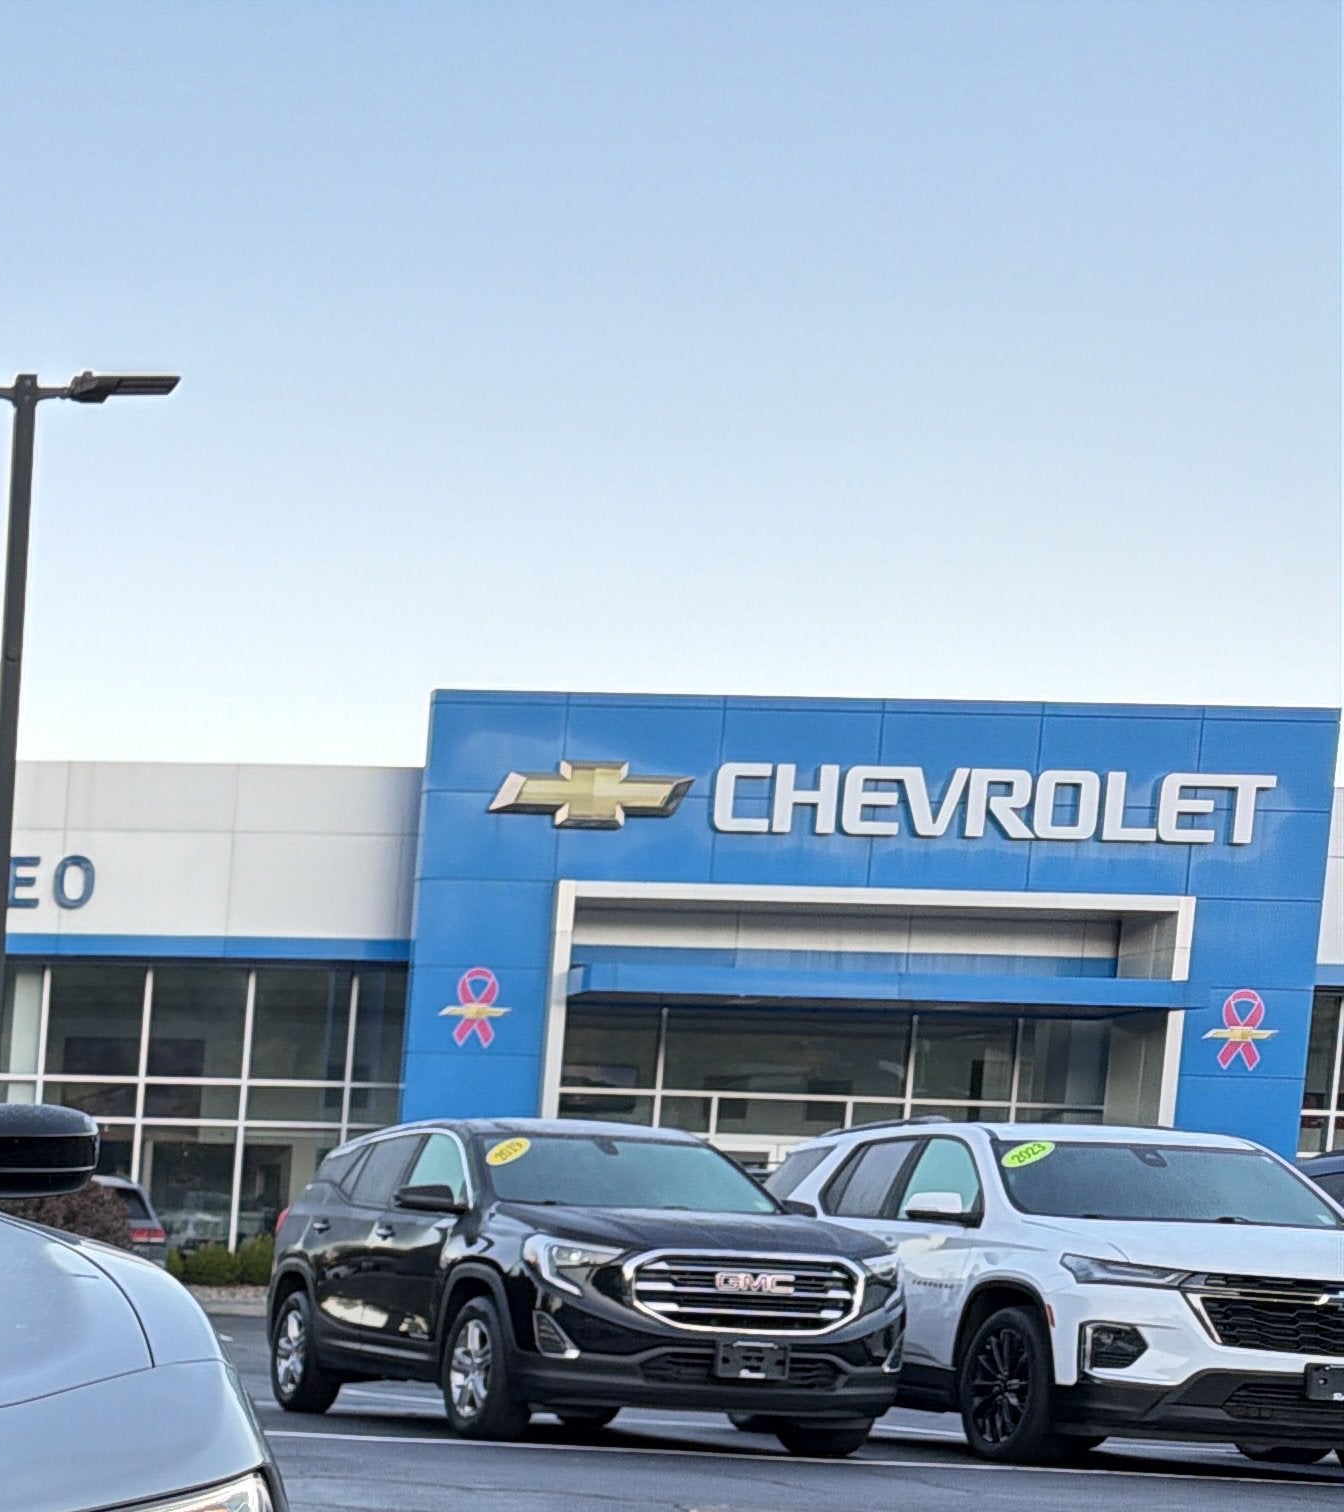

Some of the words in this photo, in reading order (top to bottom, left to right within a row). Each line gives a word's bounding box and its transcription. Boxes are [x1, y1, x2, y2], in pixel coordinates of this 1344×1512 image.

[713, 762, 1278, 844] CHEVROLET
[1010, 1143, 1047, 1164] 2023
[714, 1271, 796, 1294] GMC
